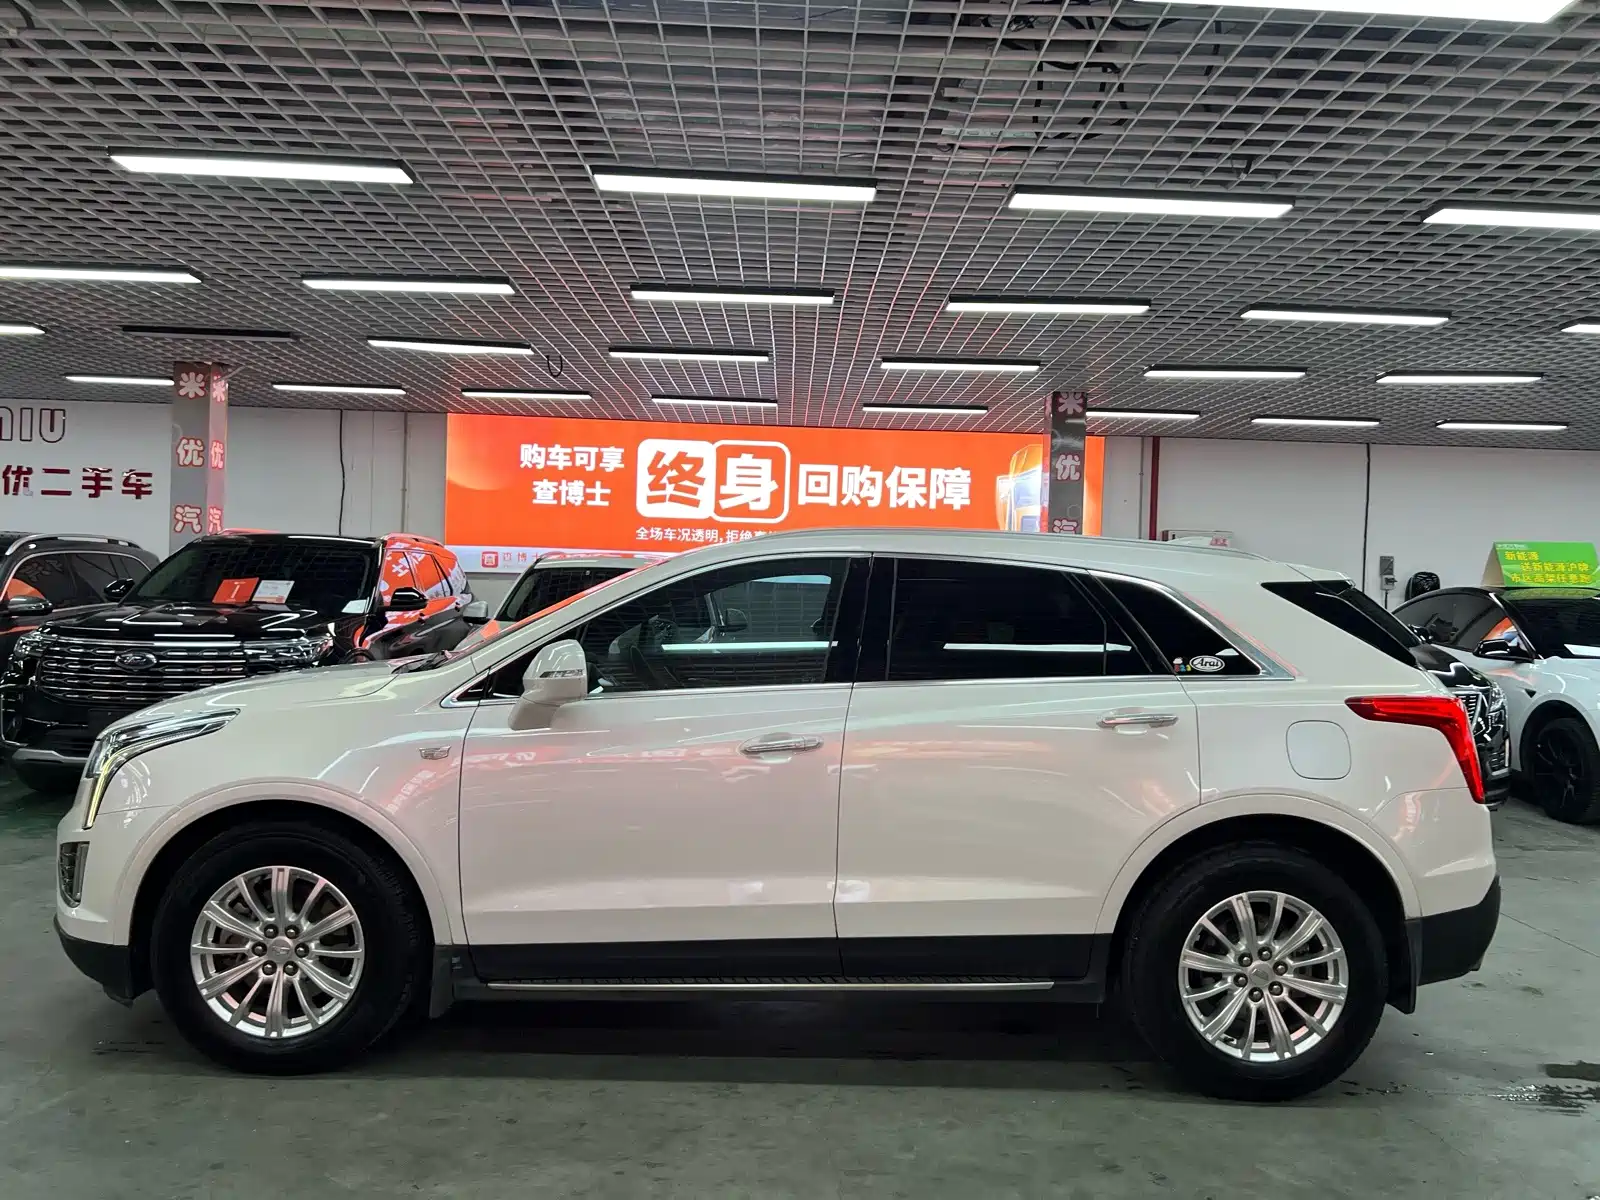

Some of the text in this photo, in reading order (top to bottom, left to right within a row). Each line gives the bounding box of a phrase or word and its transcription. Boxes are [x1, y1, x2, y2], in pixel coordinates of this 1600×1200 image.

[519, 442, 625, 472] 购车可享
[2, 464, 153, 500] 优二手车
[532, 478, 612, 507] 查博士
[647, 450, 971, 511] 终身 回购保障
